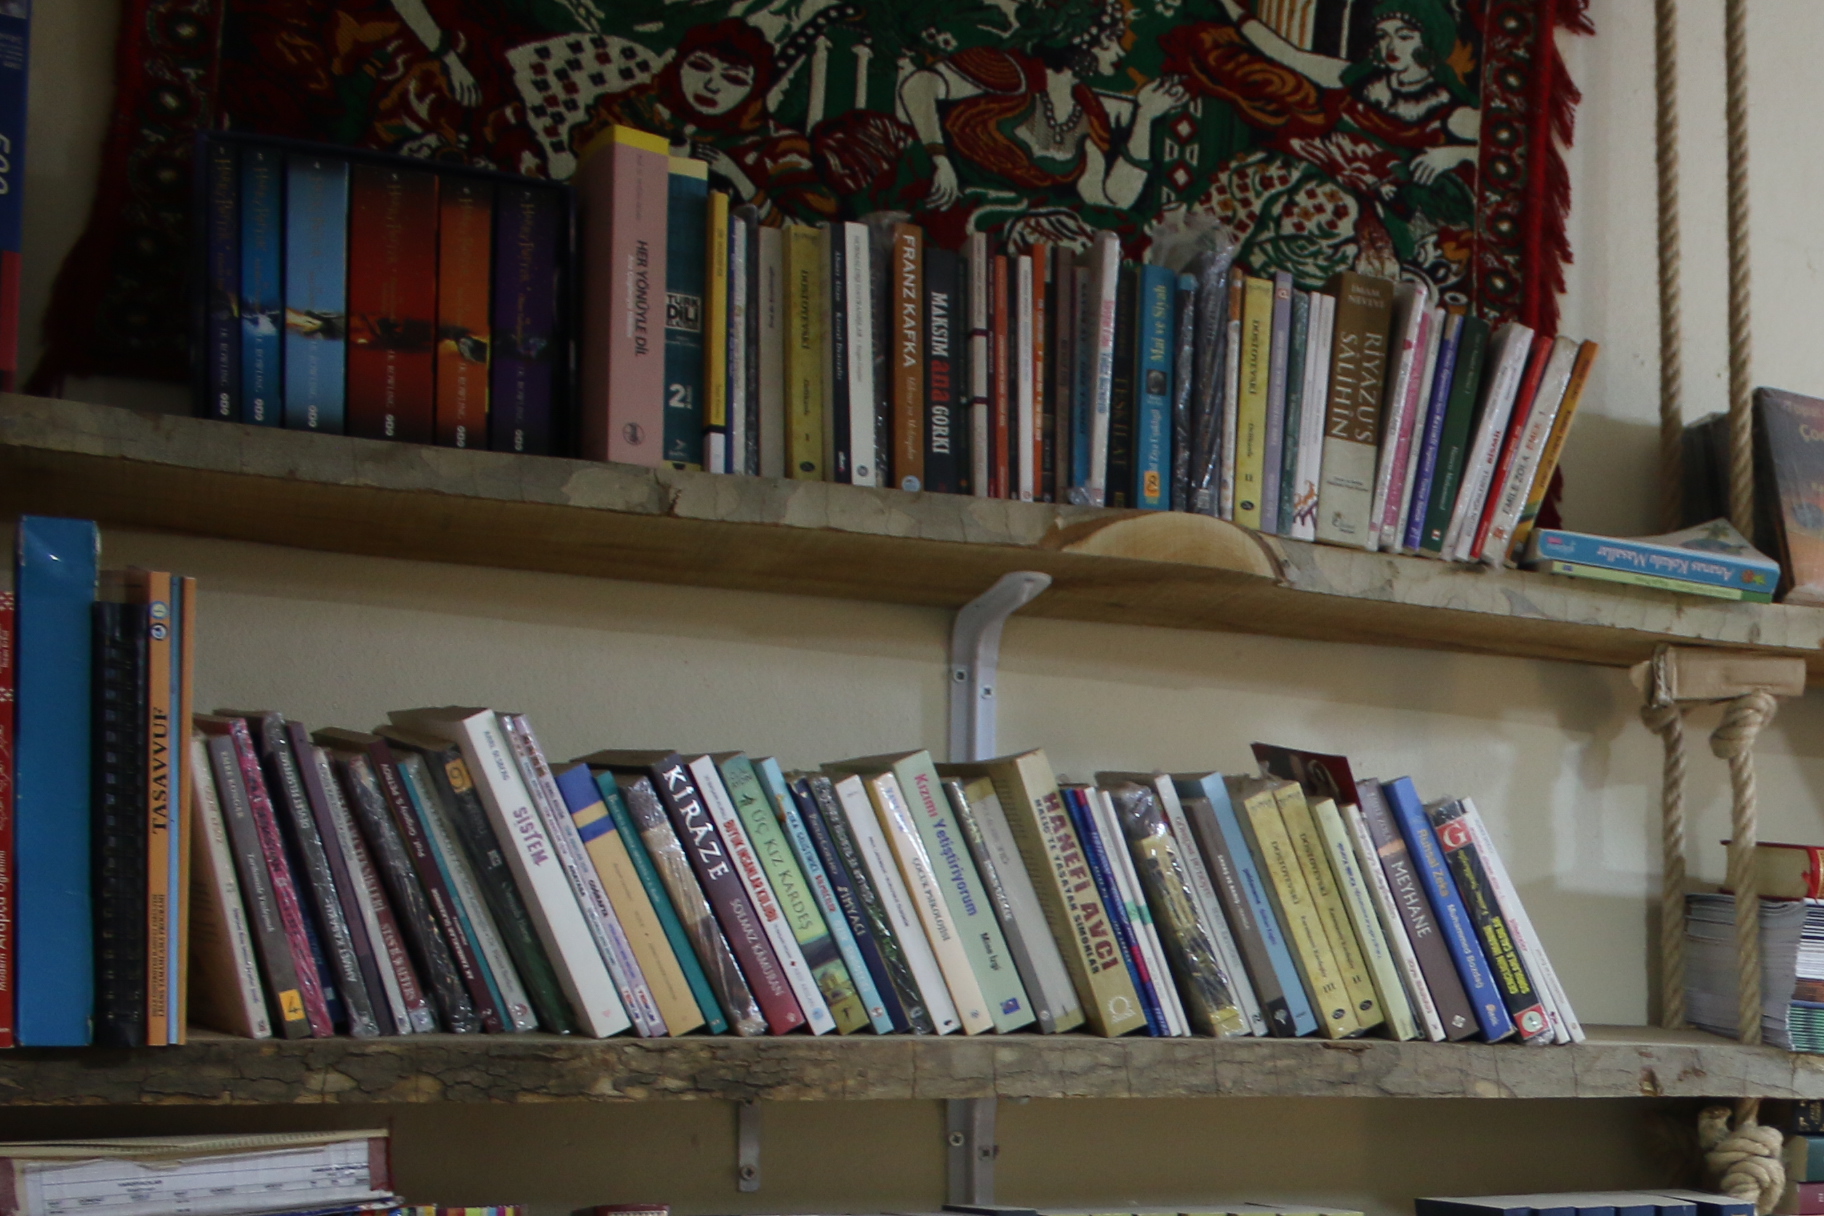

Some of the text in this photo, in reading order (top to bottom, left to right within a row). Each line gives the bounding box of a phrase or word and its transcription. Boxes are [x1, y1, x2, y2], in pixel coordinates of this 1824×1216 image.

[902, 234, 916, 368] FRANZ KAFKA
[931, 360, 950, 401] ana
[151, 708, 168, 835] TASAVVUF
[933, 818, 978, 917] Yetiştiriyorum
[1391, 861, 1432, 938] MEYHANE
[1417, 829, 1441, 870] Ruhsal
[1431, 869, 1450, 897] Zeka
[1446, 903, 1474, 955] Muhammed
[1079, 902, 1119, 971] AVCI
